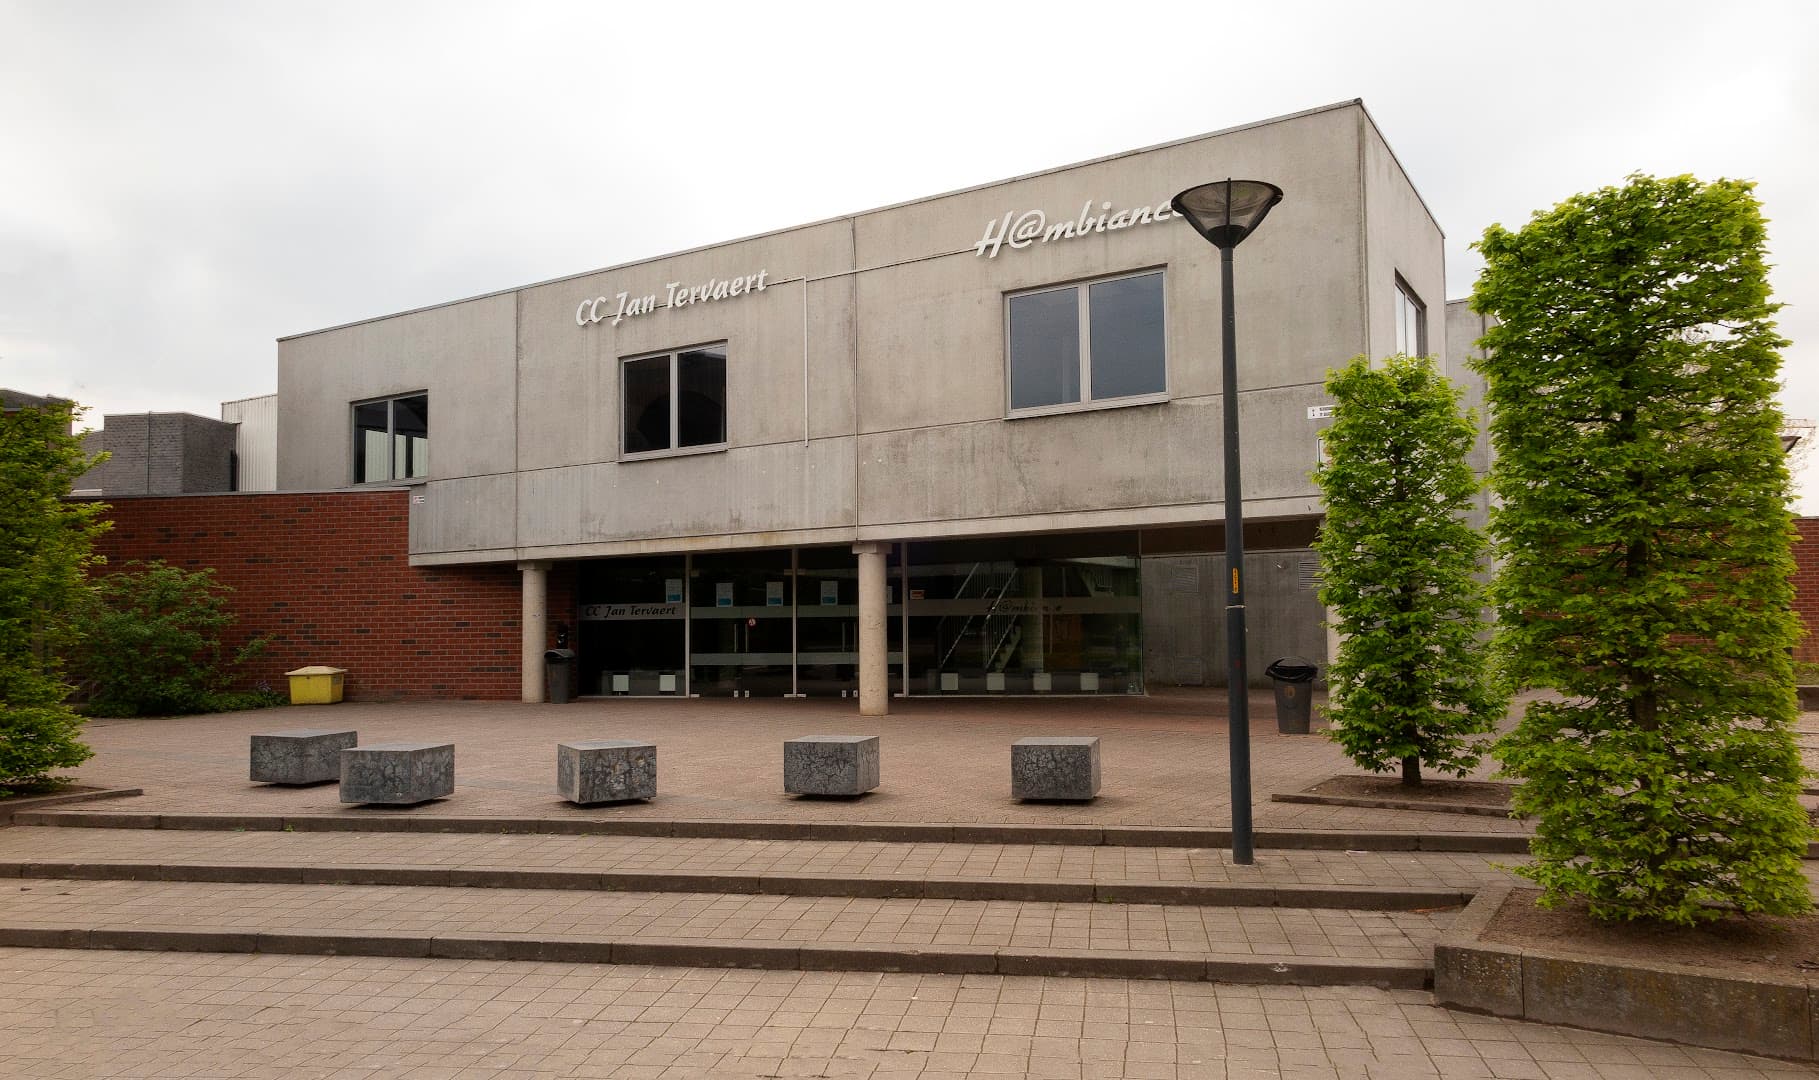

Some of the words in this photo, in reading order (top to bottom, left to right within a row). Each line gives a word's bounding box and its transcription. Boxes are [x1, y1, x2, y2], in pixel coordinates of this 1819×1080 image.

[974, 199, 1183, 258] H@mbianc
[575, 296, 607, 326] CC
[612, 291, 656, 326] Jan
[666, 269, 769, 309] Tervaert
[585, 606, 601, 617] CC
[604, 605, 626, 618] Jan
[630, 605, 677, 616] Tervaert
